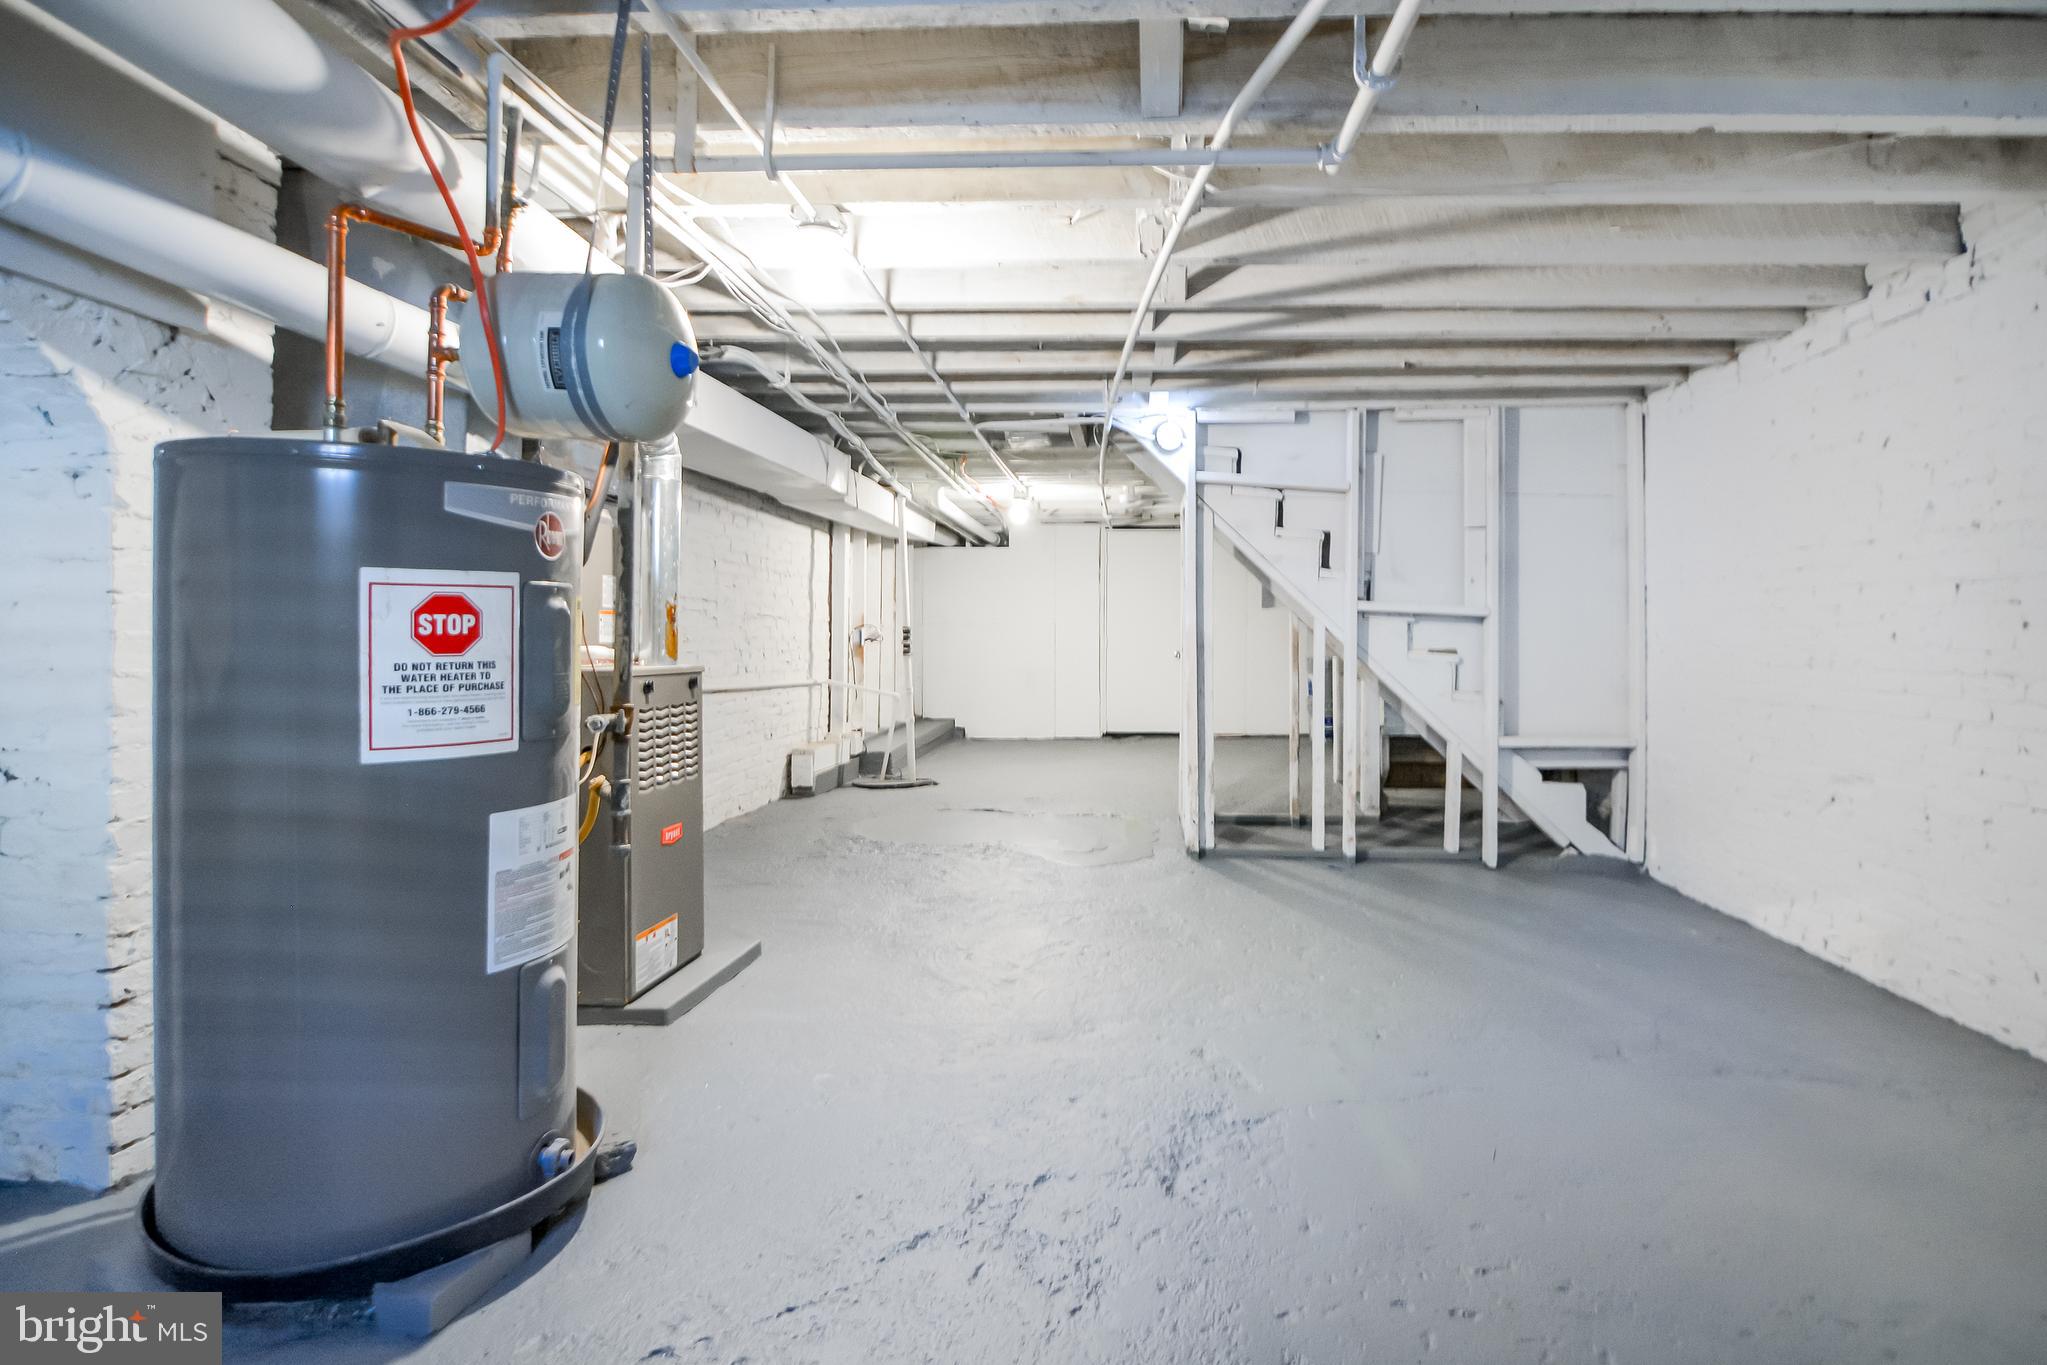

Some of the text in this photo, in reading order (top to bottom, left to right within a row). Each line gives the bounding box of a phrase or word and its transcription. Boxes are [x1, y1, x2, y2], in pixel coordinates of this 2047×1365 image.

[418, 613, 475, 635] STOP
[393, 660, 497, 672] DO NOT RETURN THIS
[401, 672, 491, 682] WATER HEATER TO
[382, 681, 505, 694] THE PLACE OF PURCHASE
[408, 704, 485, 716] 1-866-279-4566
